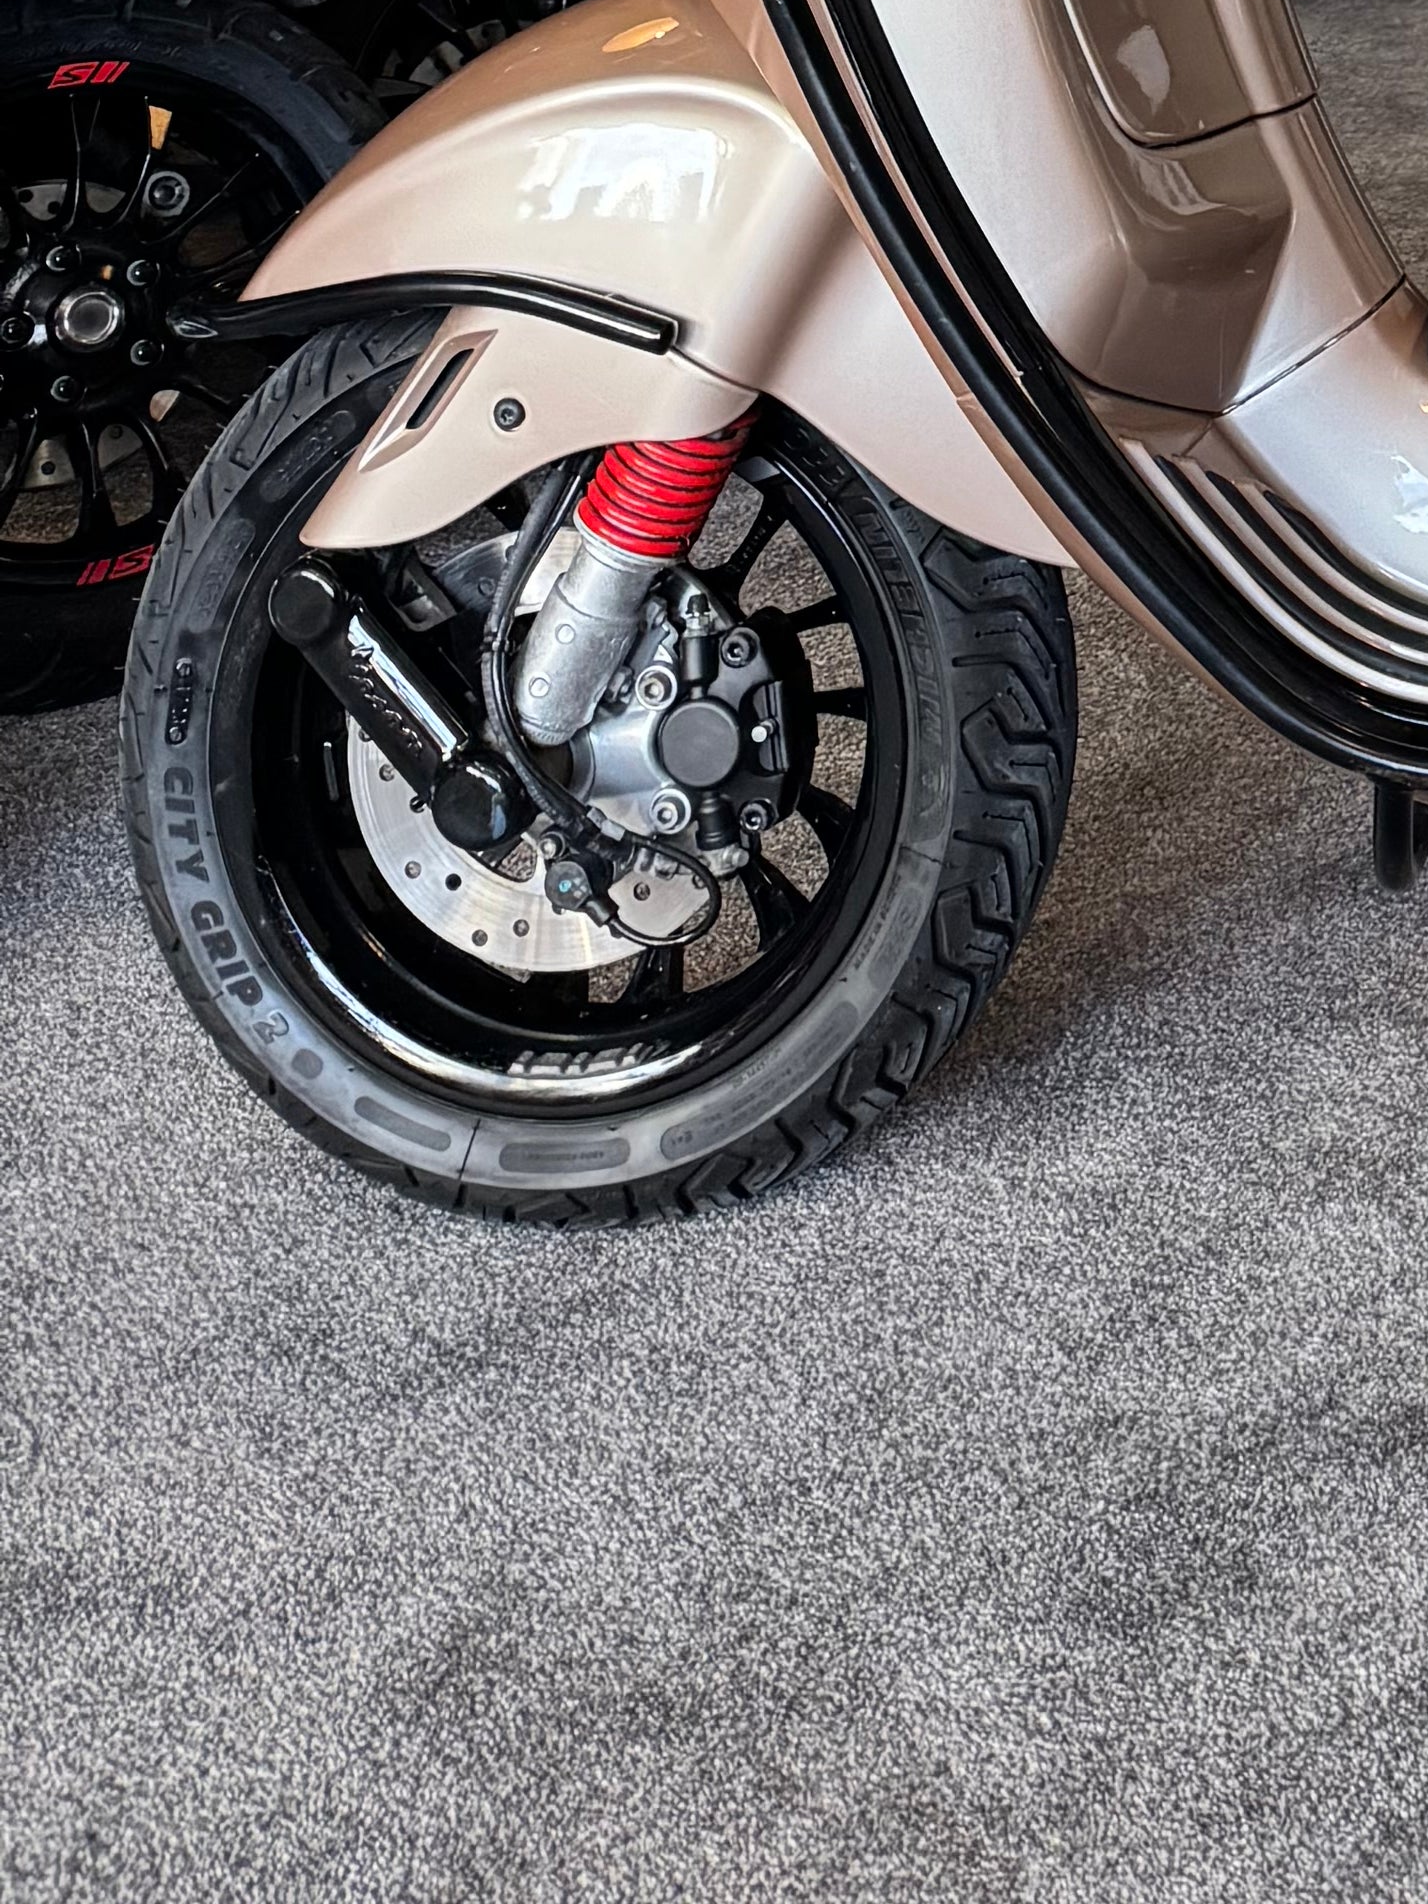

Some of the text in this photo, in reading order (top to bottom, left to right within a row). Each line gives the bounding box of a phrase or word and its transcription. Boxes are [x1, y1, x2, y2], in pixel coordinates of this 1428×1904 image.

[163, 766, 290, 1044] CITY GRIP 2
